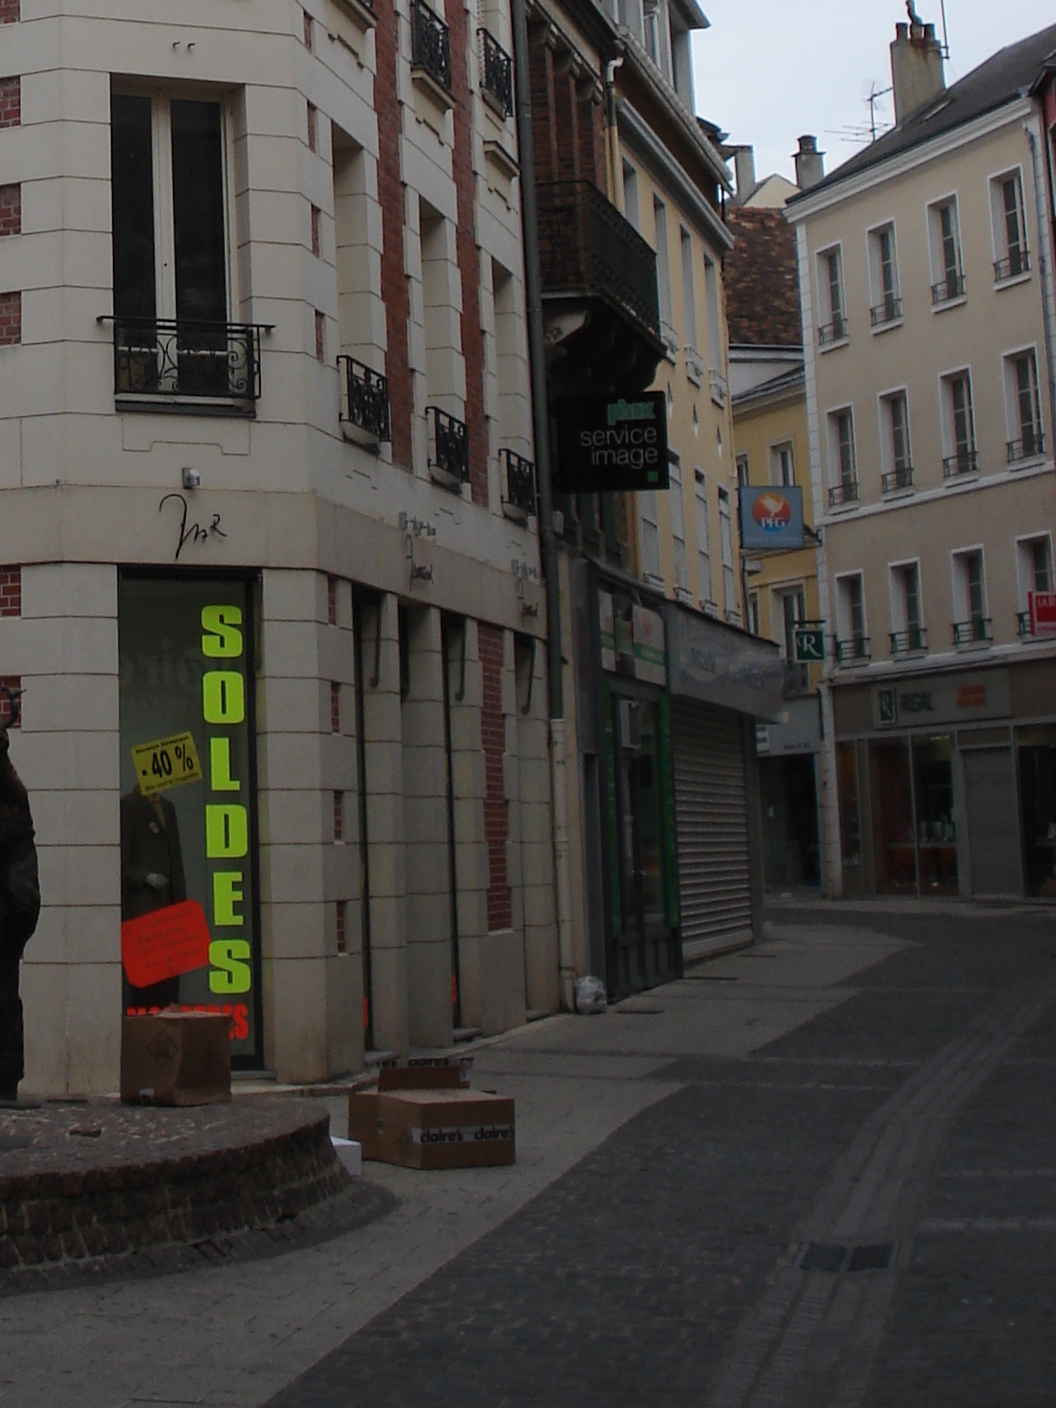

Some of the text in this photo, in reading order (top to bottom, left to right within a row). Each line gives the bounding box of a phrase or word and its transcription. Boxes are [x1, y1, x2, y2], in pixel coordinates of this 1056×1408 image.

[580, 425, 657, 447] service
[590, 447, 658, 470] image
[796, 634, 822, 657] R
[151, 749, 173, 778] 40
[174, 743, 195, 772] %
[200, 604, 252, 994] SOLDES
[420, 1127, 464, 1144] claire's
